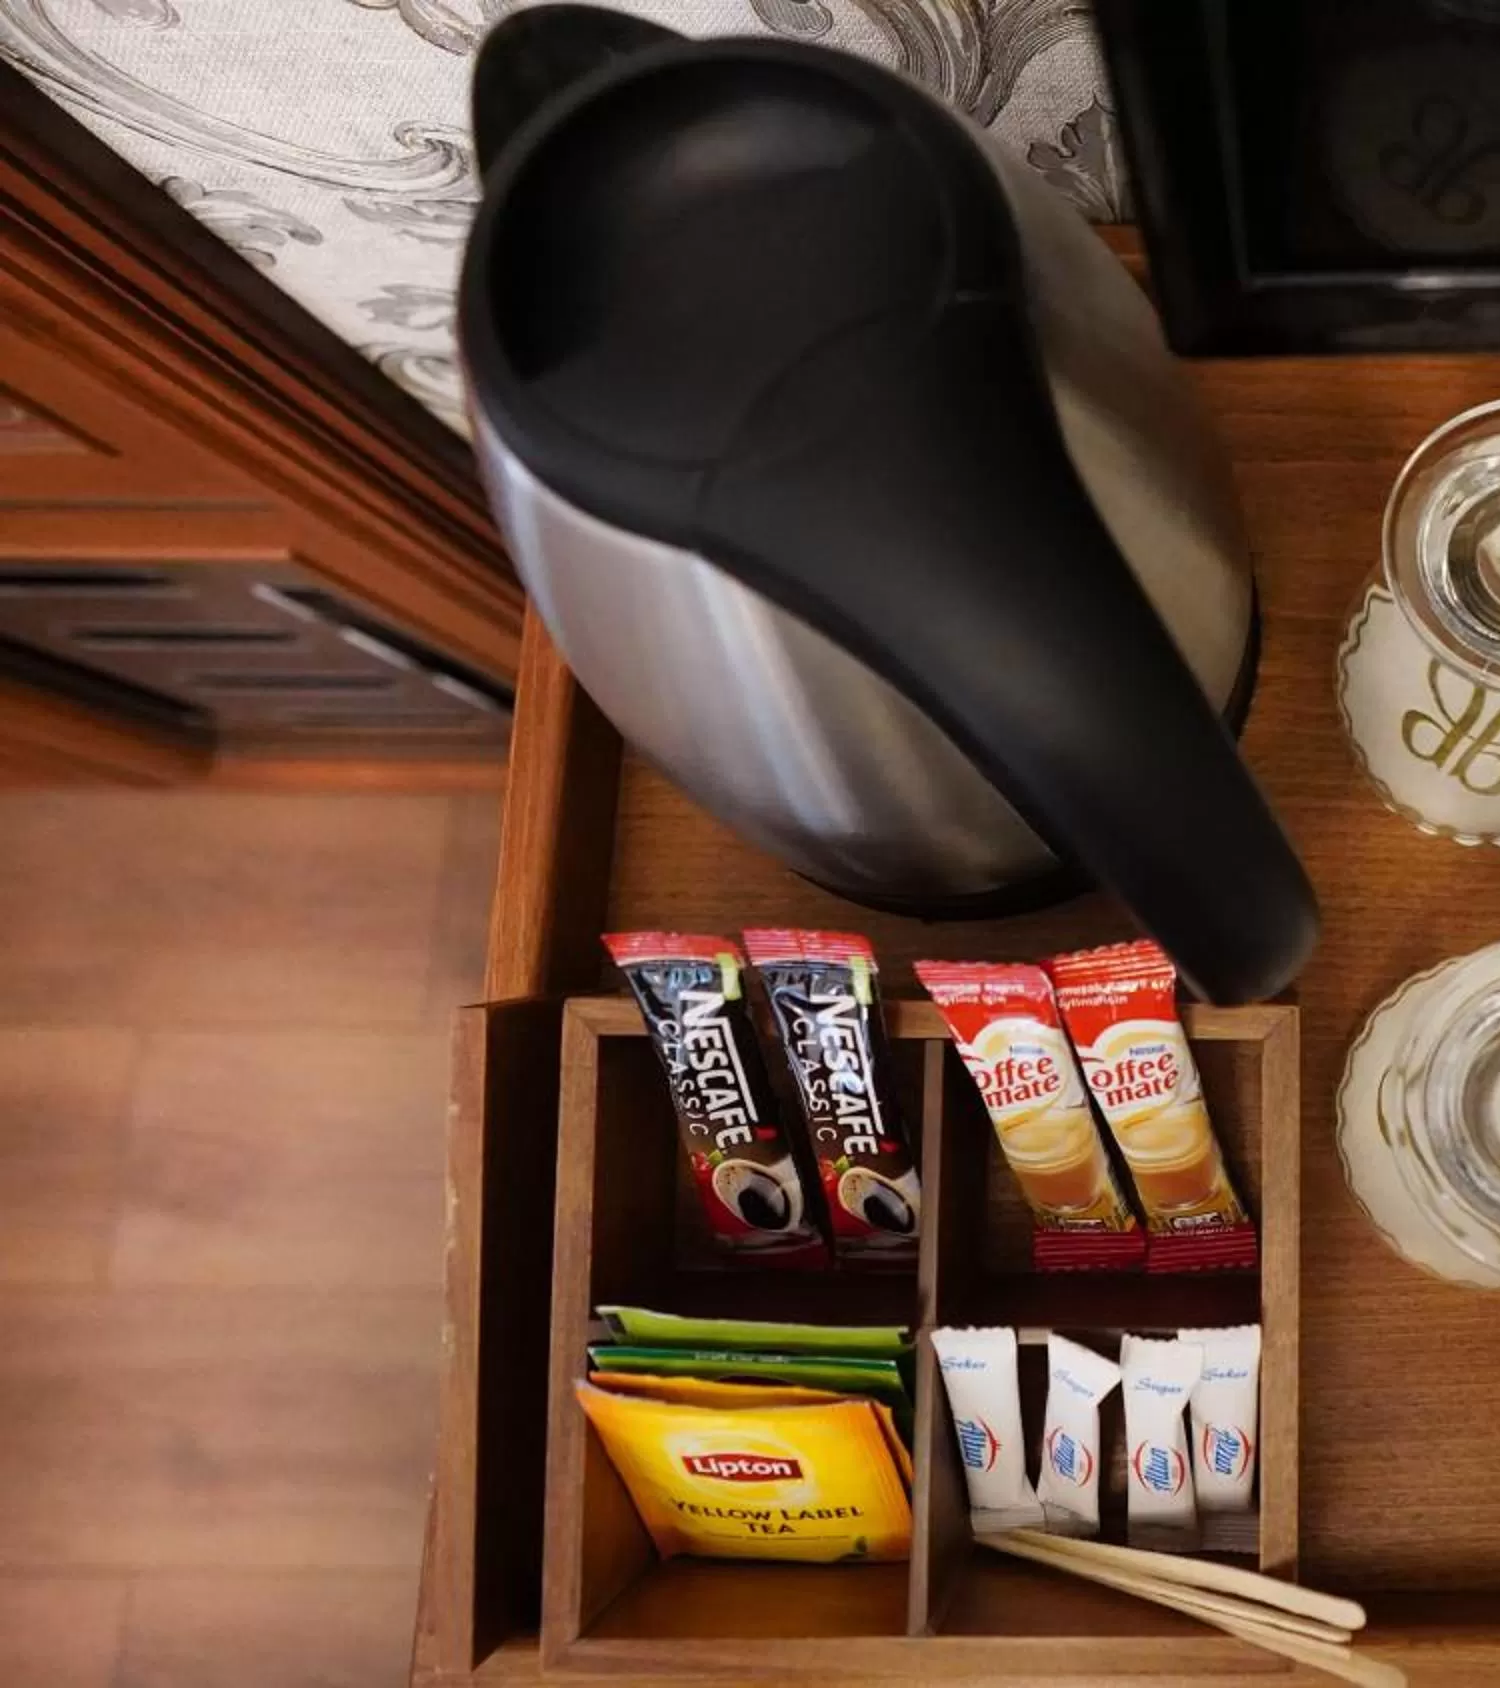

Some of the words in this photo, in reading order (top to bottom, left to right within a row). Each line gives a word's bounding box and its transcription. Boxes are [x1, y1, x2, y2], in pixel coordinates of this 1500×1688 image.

[658, 1018, 709, 1137] CLASSIC
[793, 1017, 837, 1142] CLASSIC
[960, 1054, 1054, 1091] offee
[985, 1071, 1061, 1109] mate
[1106, 1068, 1180, 1107] mate
[691, 1458, 793, 1479] Lipton
[671, 1498, 771, 1520] YELLOW
[780, 1506, 864, 1520] LABEL
[742, 1521, 796, 1535] TEA
